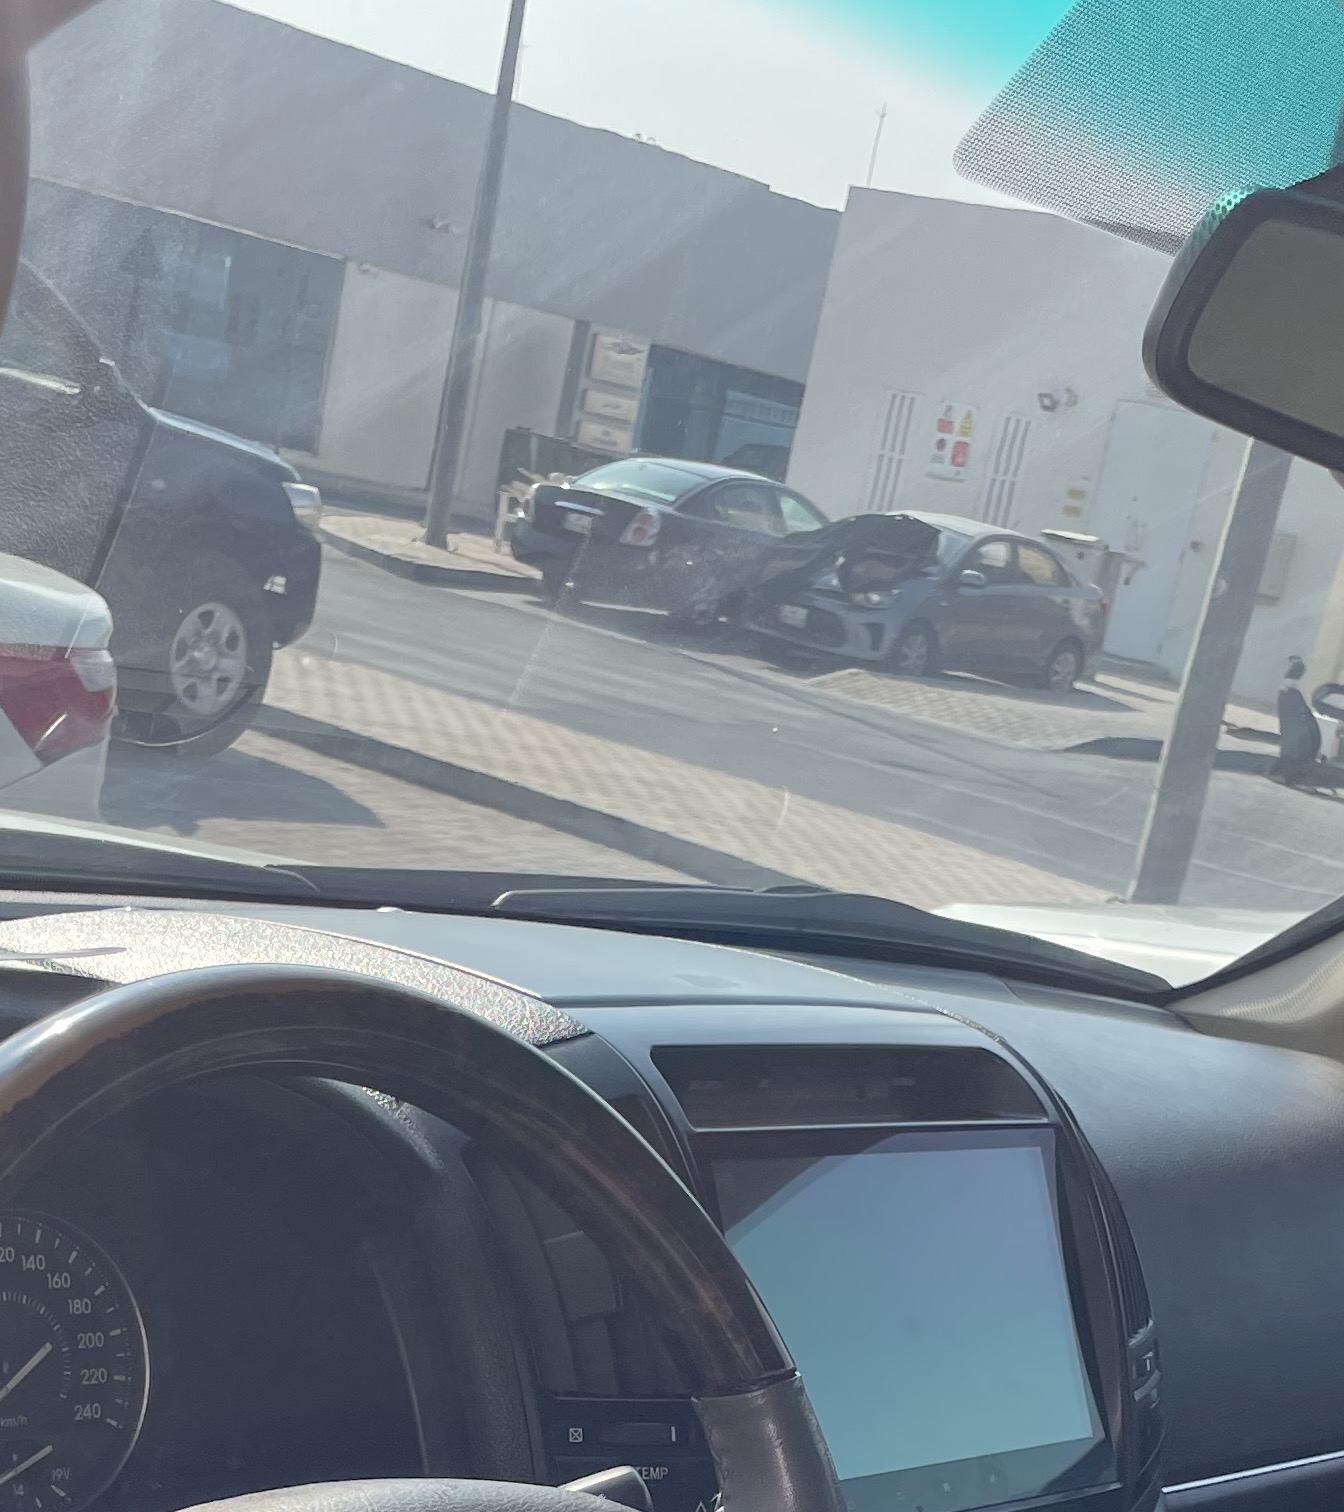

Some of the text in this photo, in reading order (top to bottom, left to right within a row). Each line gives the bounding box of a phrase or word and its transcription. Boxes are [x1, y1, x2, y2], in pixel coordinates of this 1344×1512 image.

[21, 1254, 46, 1271] 140
[47, 1272, 71, 1289] 160
[68, 1299, 92, 1315] 180
[77, 1332, 105, 1348] 200
[80, 1368, 108, 1385] 220
[74, 1403, 102, 1420] 240
